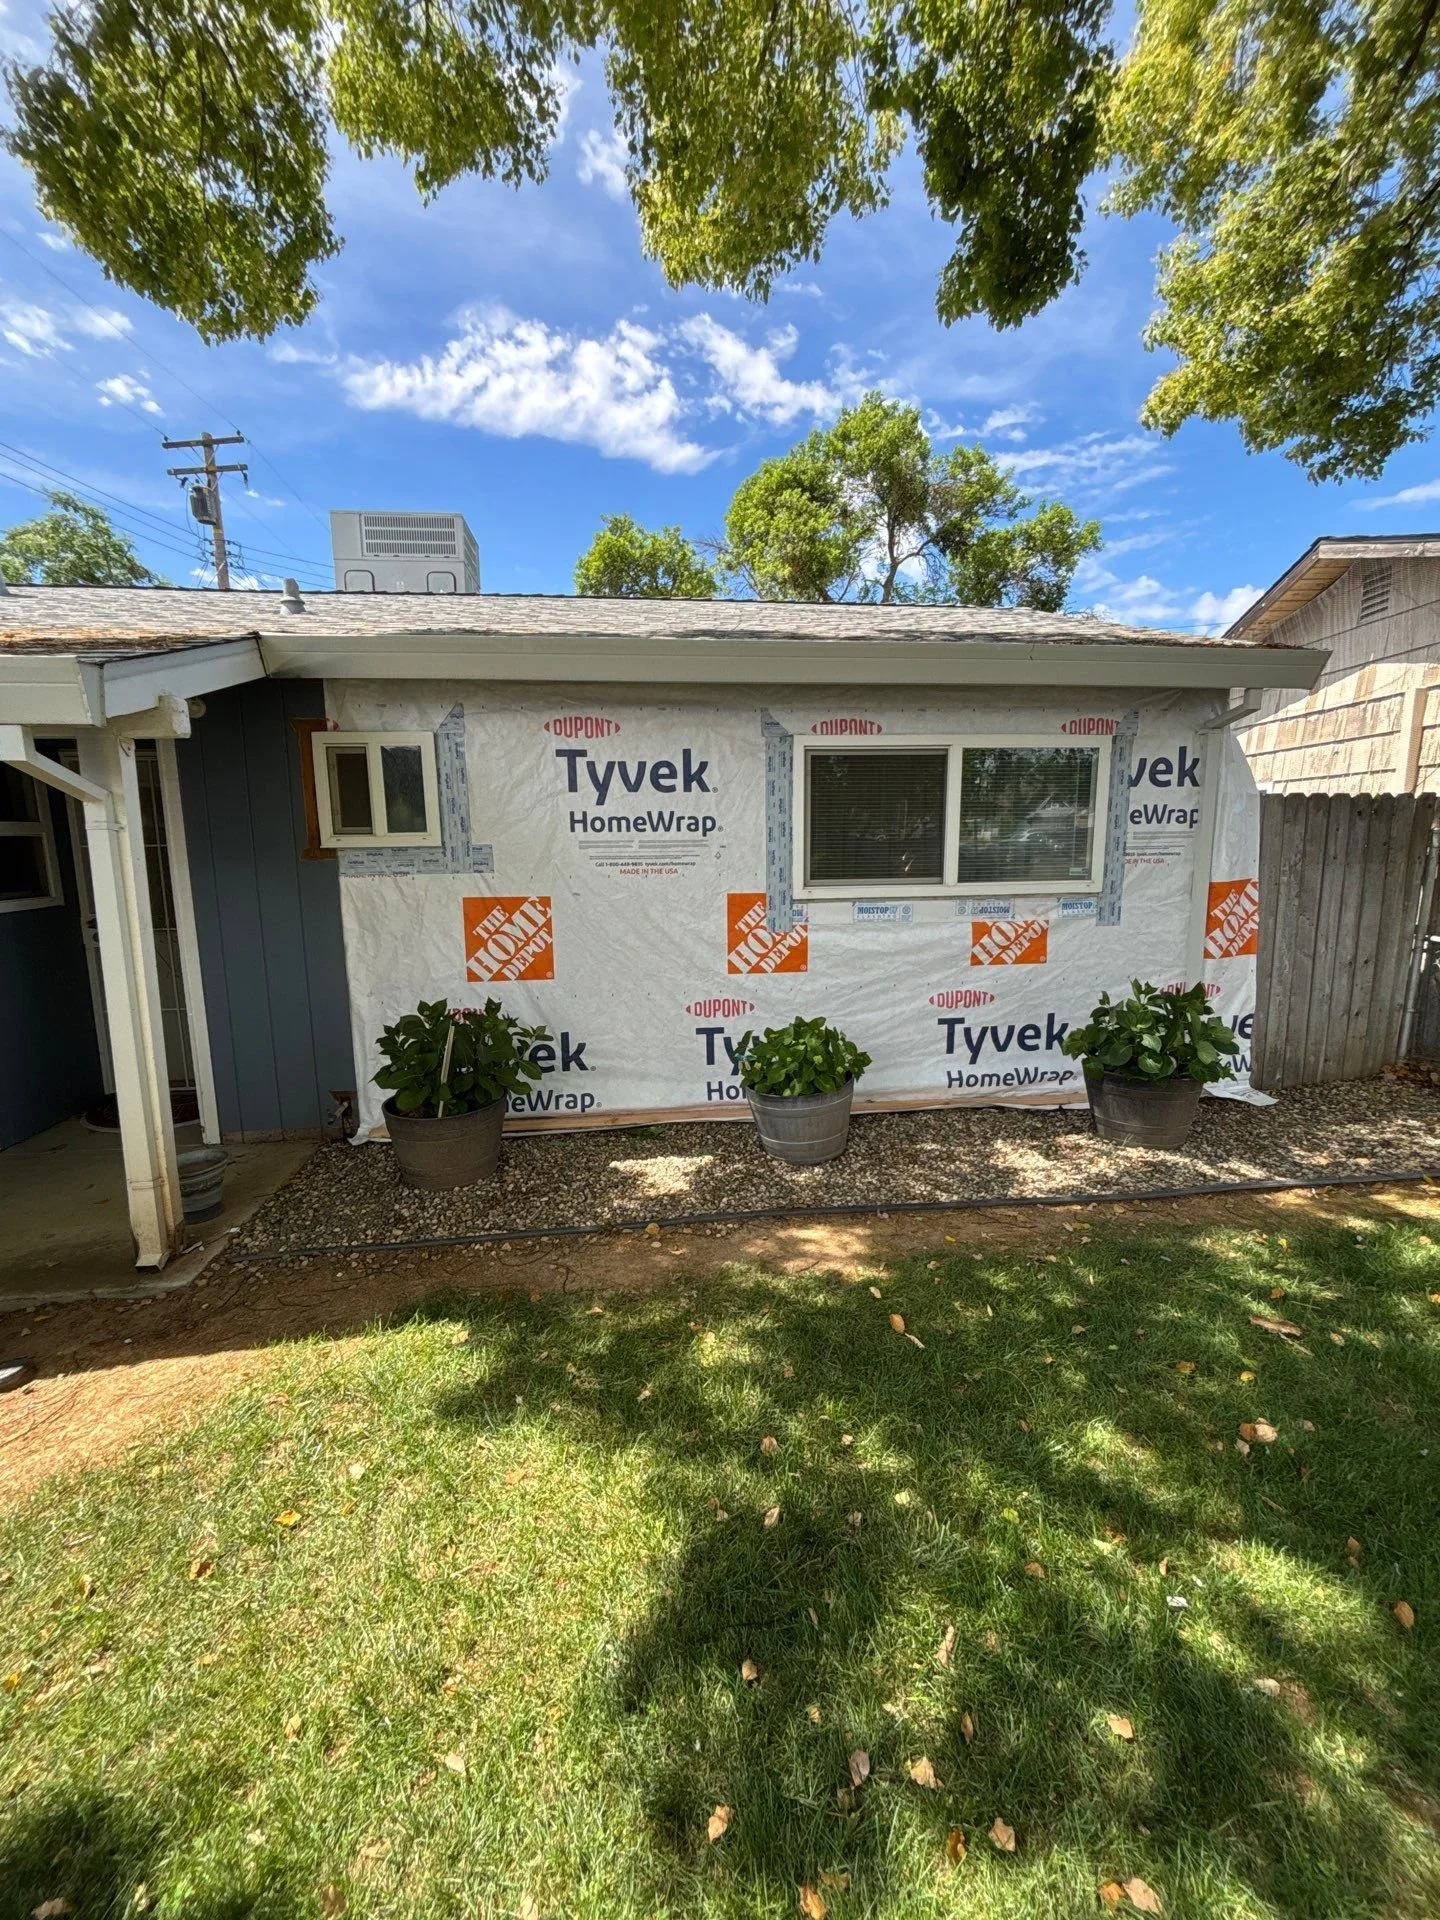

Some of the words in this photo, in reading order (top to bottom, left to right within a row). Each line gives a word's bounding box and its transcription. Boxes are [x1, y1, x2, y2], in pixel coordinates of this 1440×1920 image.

[553, 716, 612, 739] DUPONT
[820, 719, 876, 736] DUPONT
[555, 748, 711, 806] Tyvek
[1129, 746, 1200, 788] vek
[569, 810, 717, 838] HomeWrap
[1129, 804, 1199, 829] eWrap
[735, 901, 767, 935] THE
[1210, 888, 1239, 921] THE
[473, 905, 510, 941] THE
[466, 896, 552, 981] HOME
[501, 927, 553, 981] DEPOT
[694, 998, 748, 1018] DUPONT
[937, 989, 987, 1009] DUPONT
[937, 1012, 1069, 1065] Tyvek
[946, 1066, 1075, 1089] HomeWrap
[504, 1089, 595, 1113] eWrap
